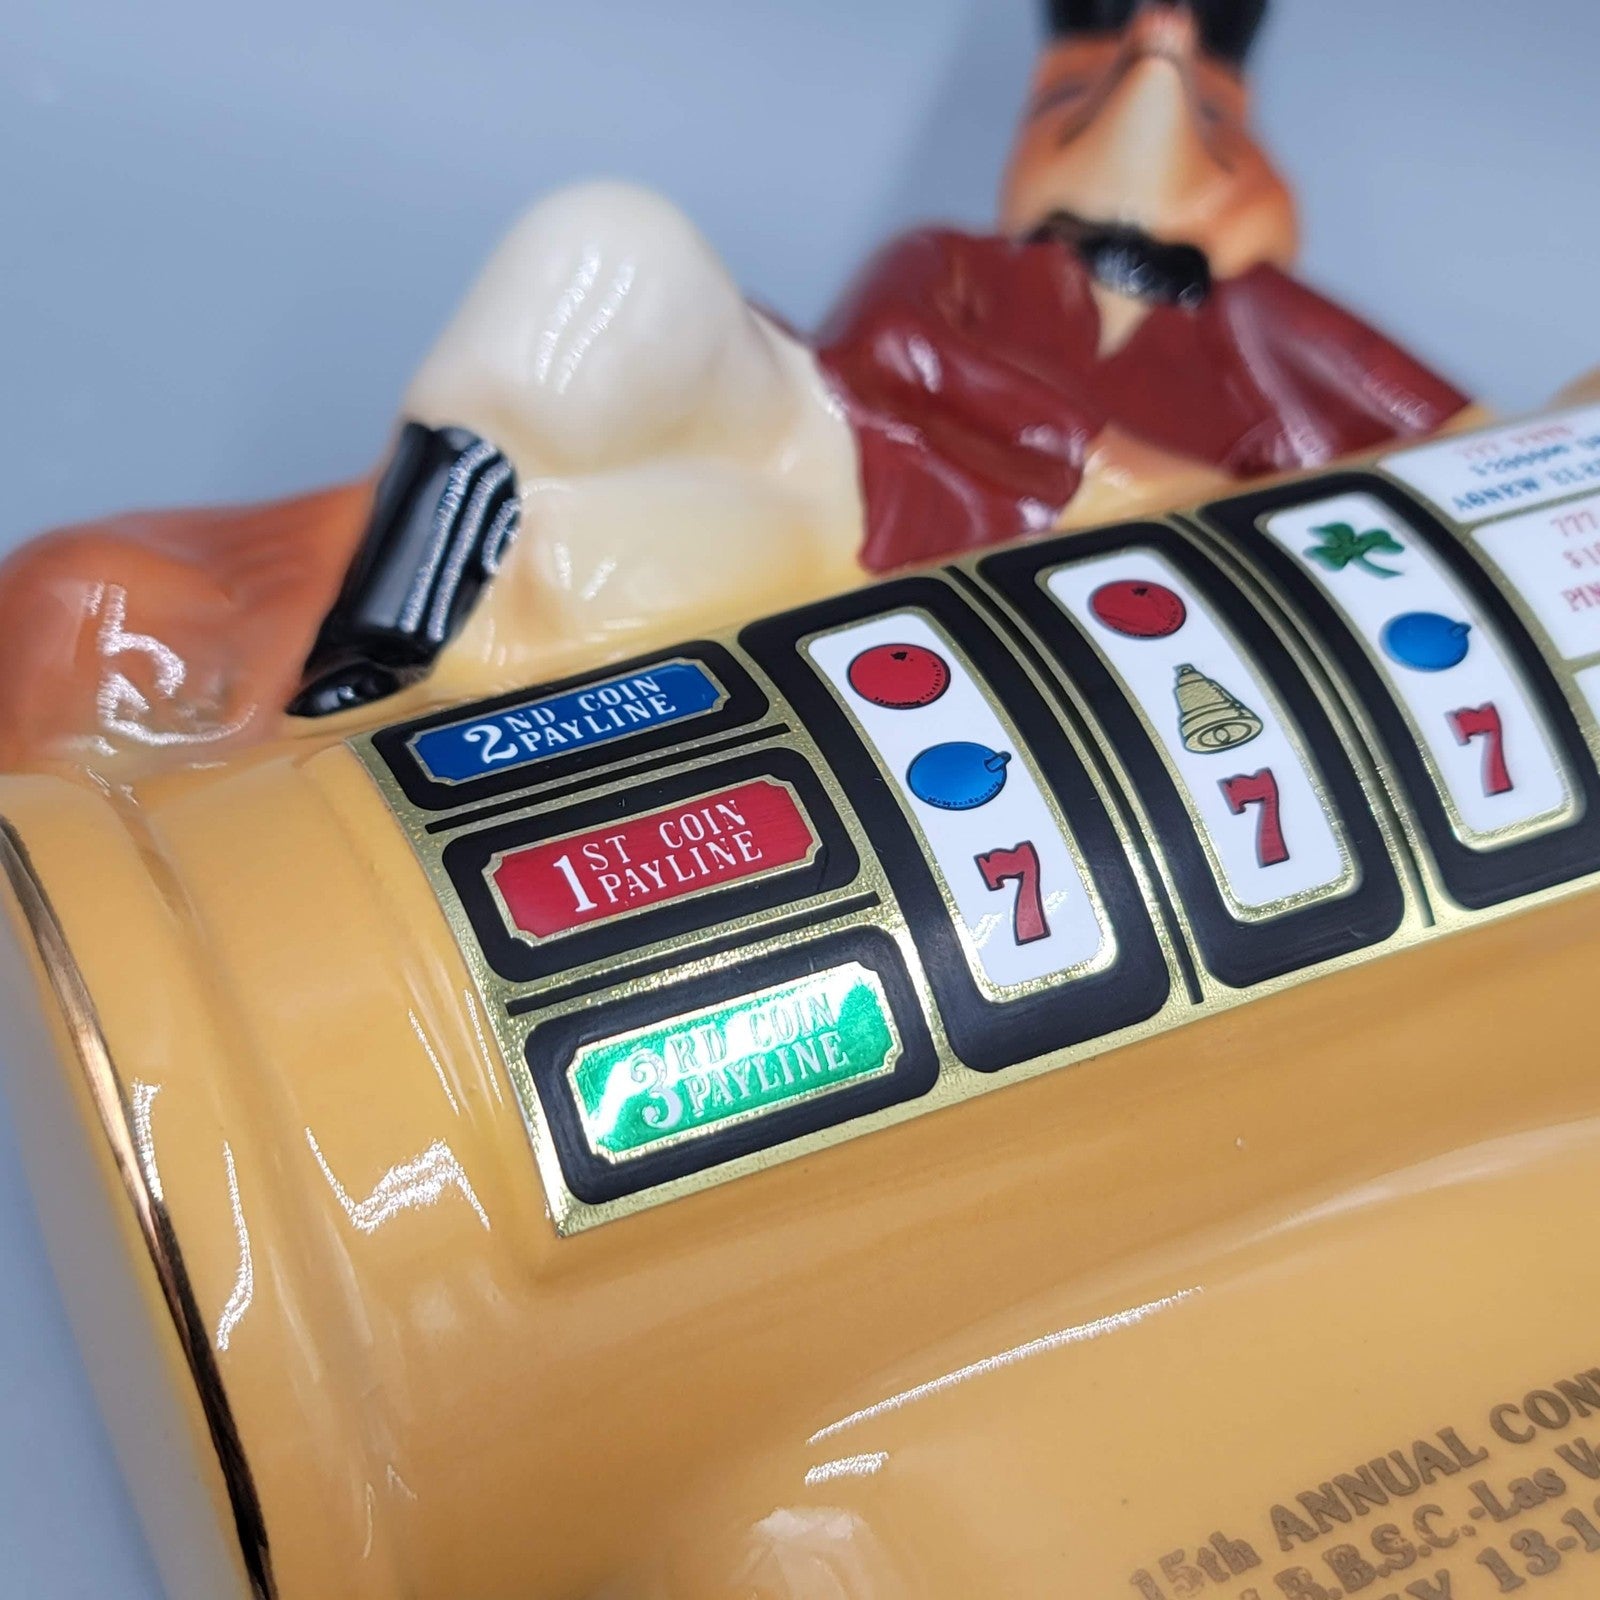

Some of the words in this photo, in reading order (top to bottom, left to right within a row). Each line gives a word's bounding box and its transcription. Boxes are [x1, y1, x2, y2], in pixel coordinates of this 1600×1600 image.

[463, 707, 556, 764] 2ND
[578, 675, 661, 712] COIN
[518, 693, 677, 752] PAYLINE
[1444, 701, 1514, 798] 7
[553, 834, 632, 913] 1ST
[659, 799, 746, 848] COIN
[597, 830, 763, 903] PAYLINE
[1217, 767, 1290, 868] 7
[973, 840, 1051, 946] 7
[631, 1026, 728, 1129] 3RD
[750, 992, 839, 1047] COIN
[684, 1032, 849, 1117] PAYLINE
[1129, 1530, 1263, 1600] 15th
[1270, 1427, 1489, 1552] ANNUAL
[1489, 1368, 1600, 1444] CON
